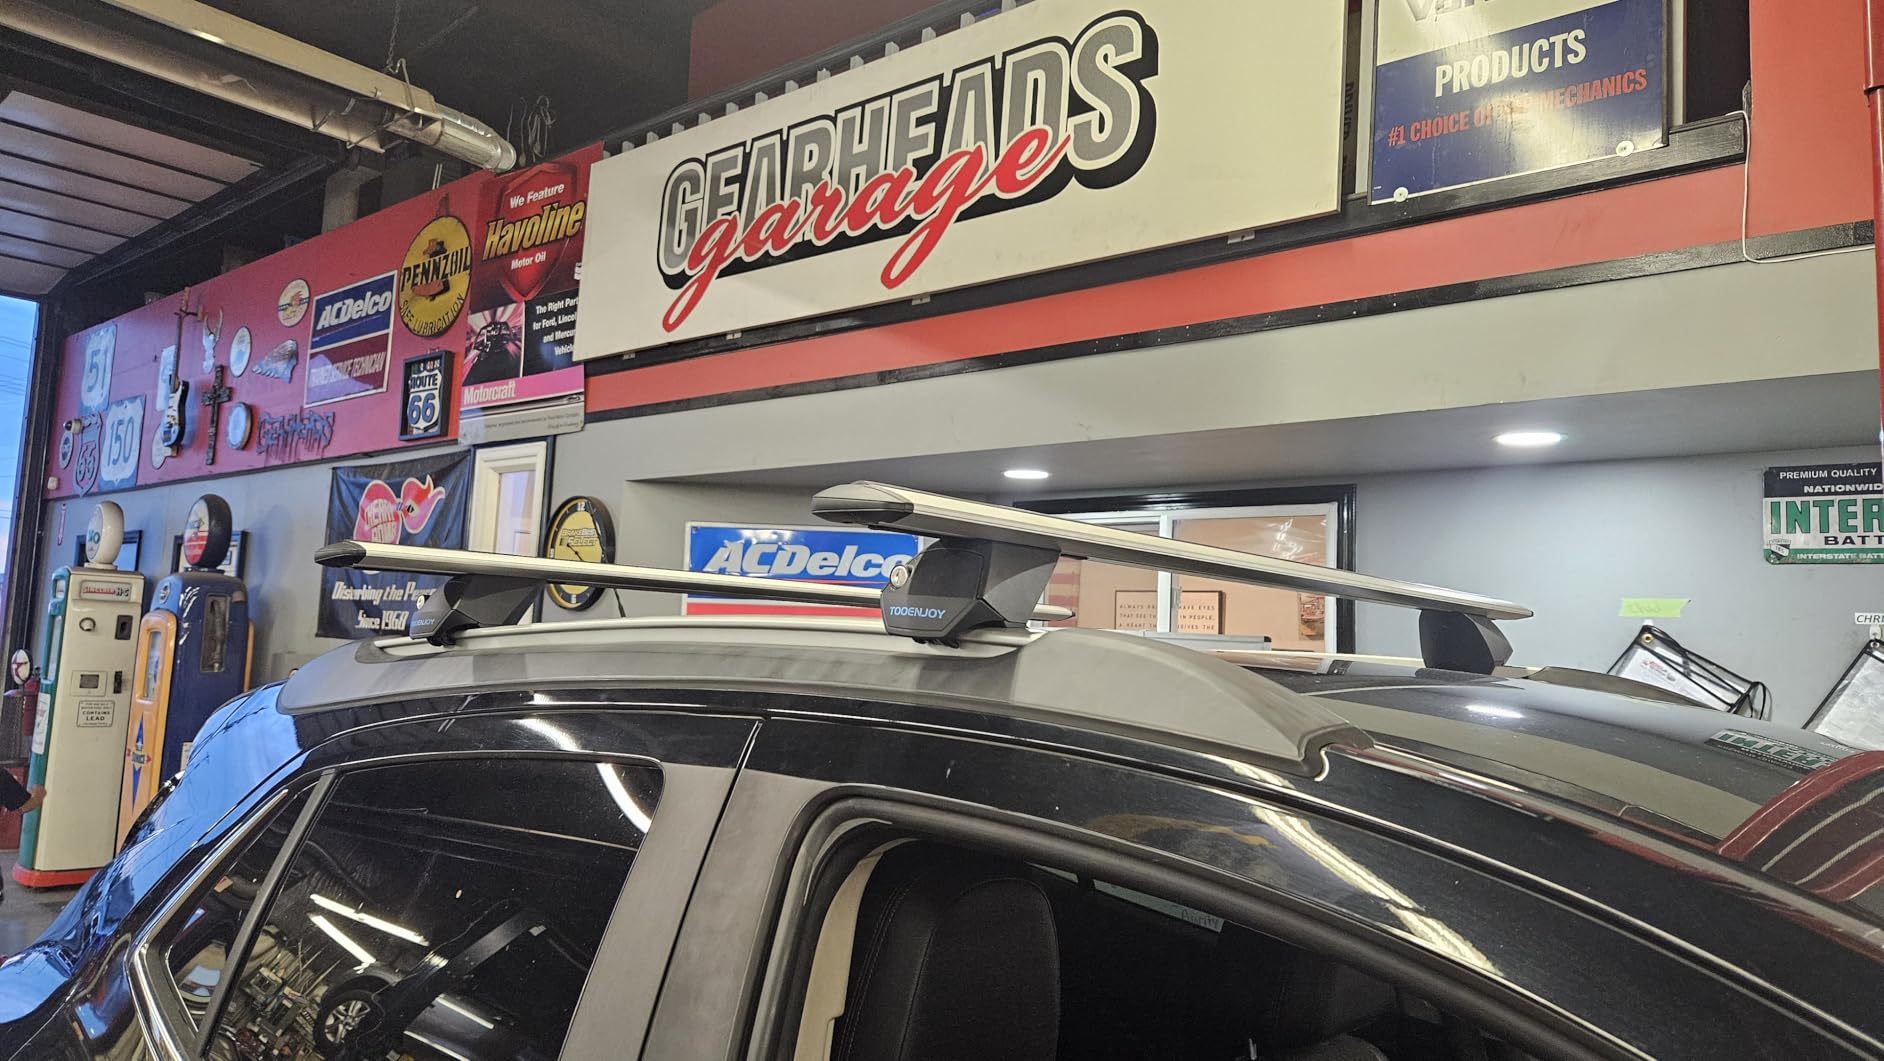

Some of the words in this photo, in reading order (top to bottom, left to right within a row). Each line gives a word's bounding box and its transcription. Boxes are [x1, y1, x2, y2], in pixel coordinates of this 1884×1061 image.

[1435, 29, 1588, 97] PRODUCTS
[1539, 69, 1649, 112] MECHANICS
[1387, 126, 1406, 147] #1
[1409, 110, 1469, 142] CHOICE
[658, 12, 1154, 284] GEARHEADS
[510, 194, 525, 209] We
[527, 183, 565, 205] Feature
[482, 200, 587, 260] Havoline
[662, 127, 1071, 333] garage
[401, 246, 471, 292] PENNZOIL
[511, 254, 534, 270] Motor
[535, 251, 547, 264] Oil
[316, 290, 393, 331] ACDelco
[413, 293, 466, 335] LUBRICATION
[536, 305, 547, 314] The
[548, 300, 564, 312] Right
[533, 321, 541, 330] for
[542, 316, 557, 328] Ford,
[543, 332, 554, 343] and
[554, 344, 574, 356] Vehicl
[410, 373, 438, 389] ROUTE
[464, 381, 516, 405] Motorcraft
[408, 393, 436, 425] 66
[107, 416, 133, 467] 150
[1779, 470, 1828, 479] PREMIUM
[1831, 468, 1877, 477] QUALITY
[1803, 483, 1883, 493] NATIONWID
[1770, 498, 1884, 534] INTER
[1824, 535, 1884, 545] BATT
[332, 581, 383, 606] Disturbing
[383, 584, 404, 601] the
[355, 609, 381, 629] Since
[381, 610, 409, 630] 1968
[889, 606, 946, 619] TOOENJOY
